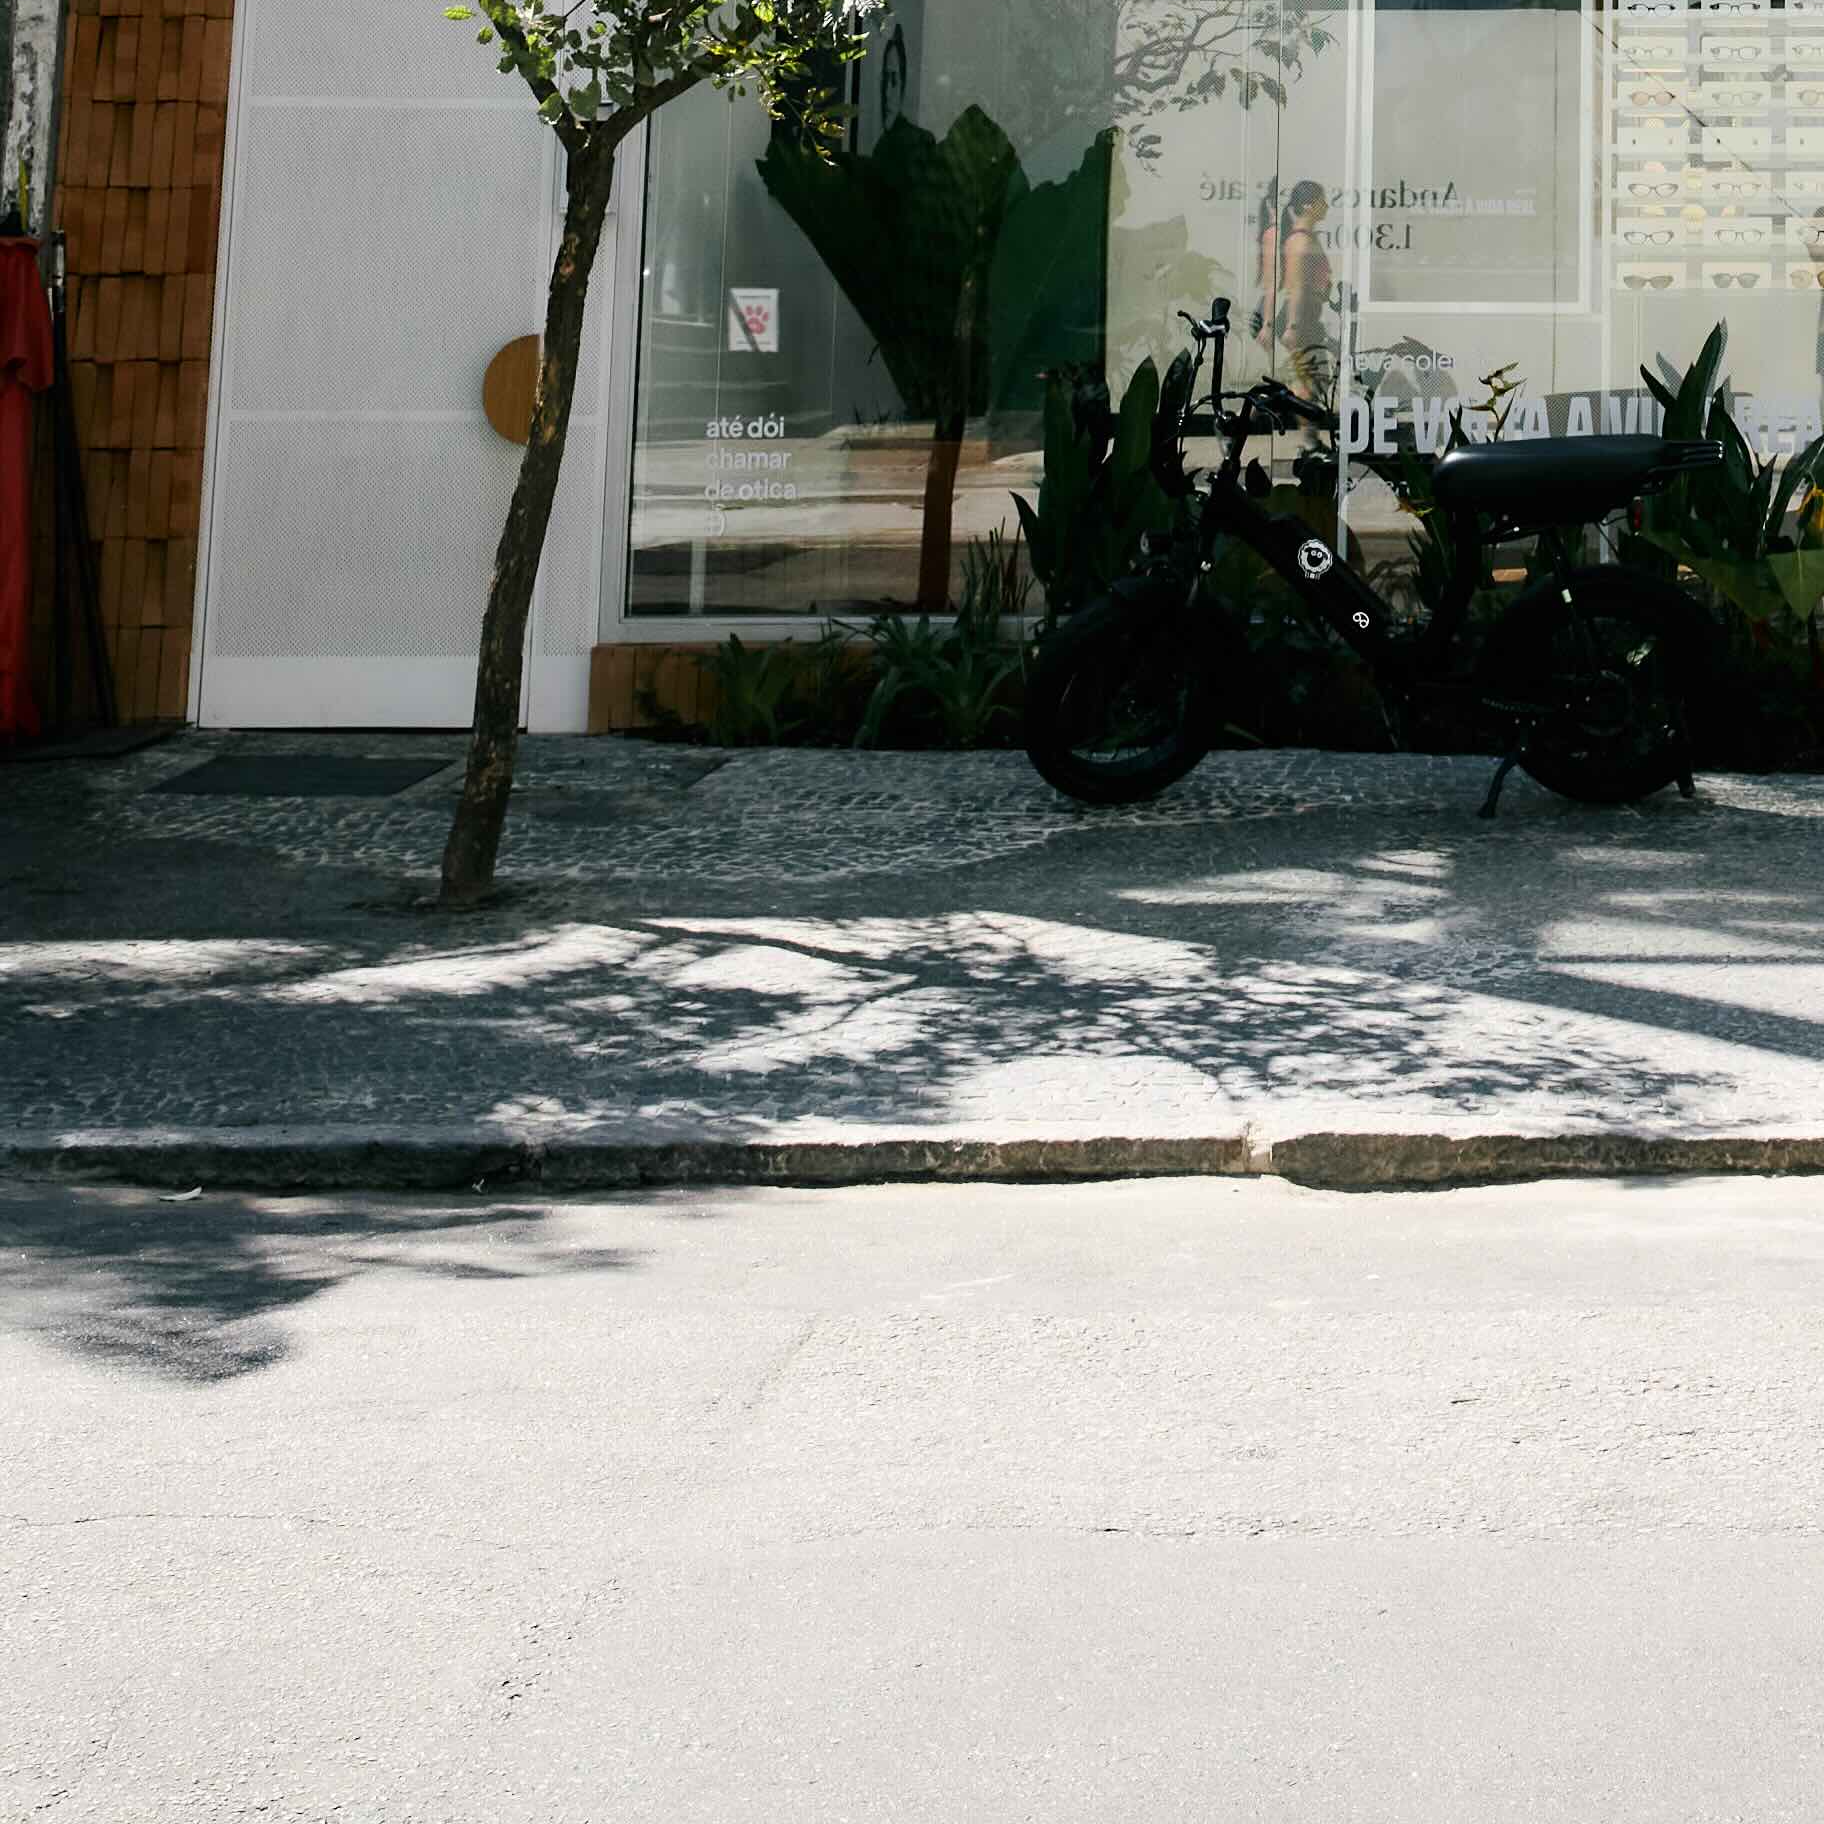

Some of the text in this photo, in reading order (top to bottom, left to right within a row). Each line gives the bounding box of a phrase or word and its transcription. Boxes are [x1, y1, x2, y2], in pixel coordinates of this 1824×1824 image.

[706, 412, 785, 439] até dói
[1341, 397, 1398, 455] DE
[706, 448, 792, 471] chamar
